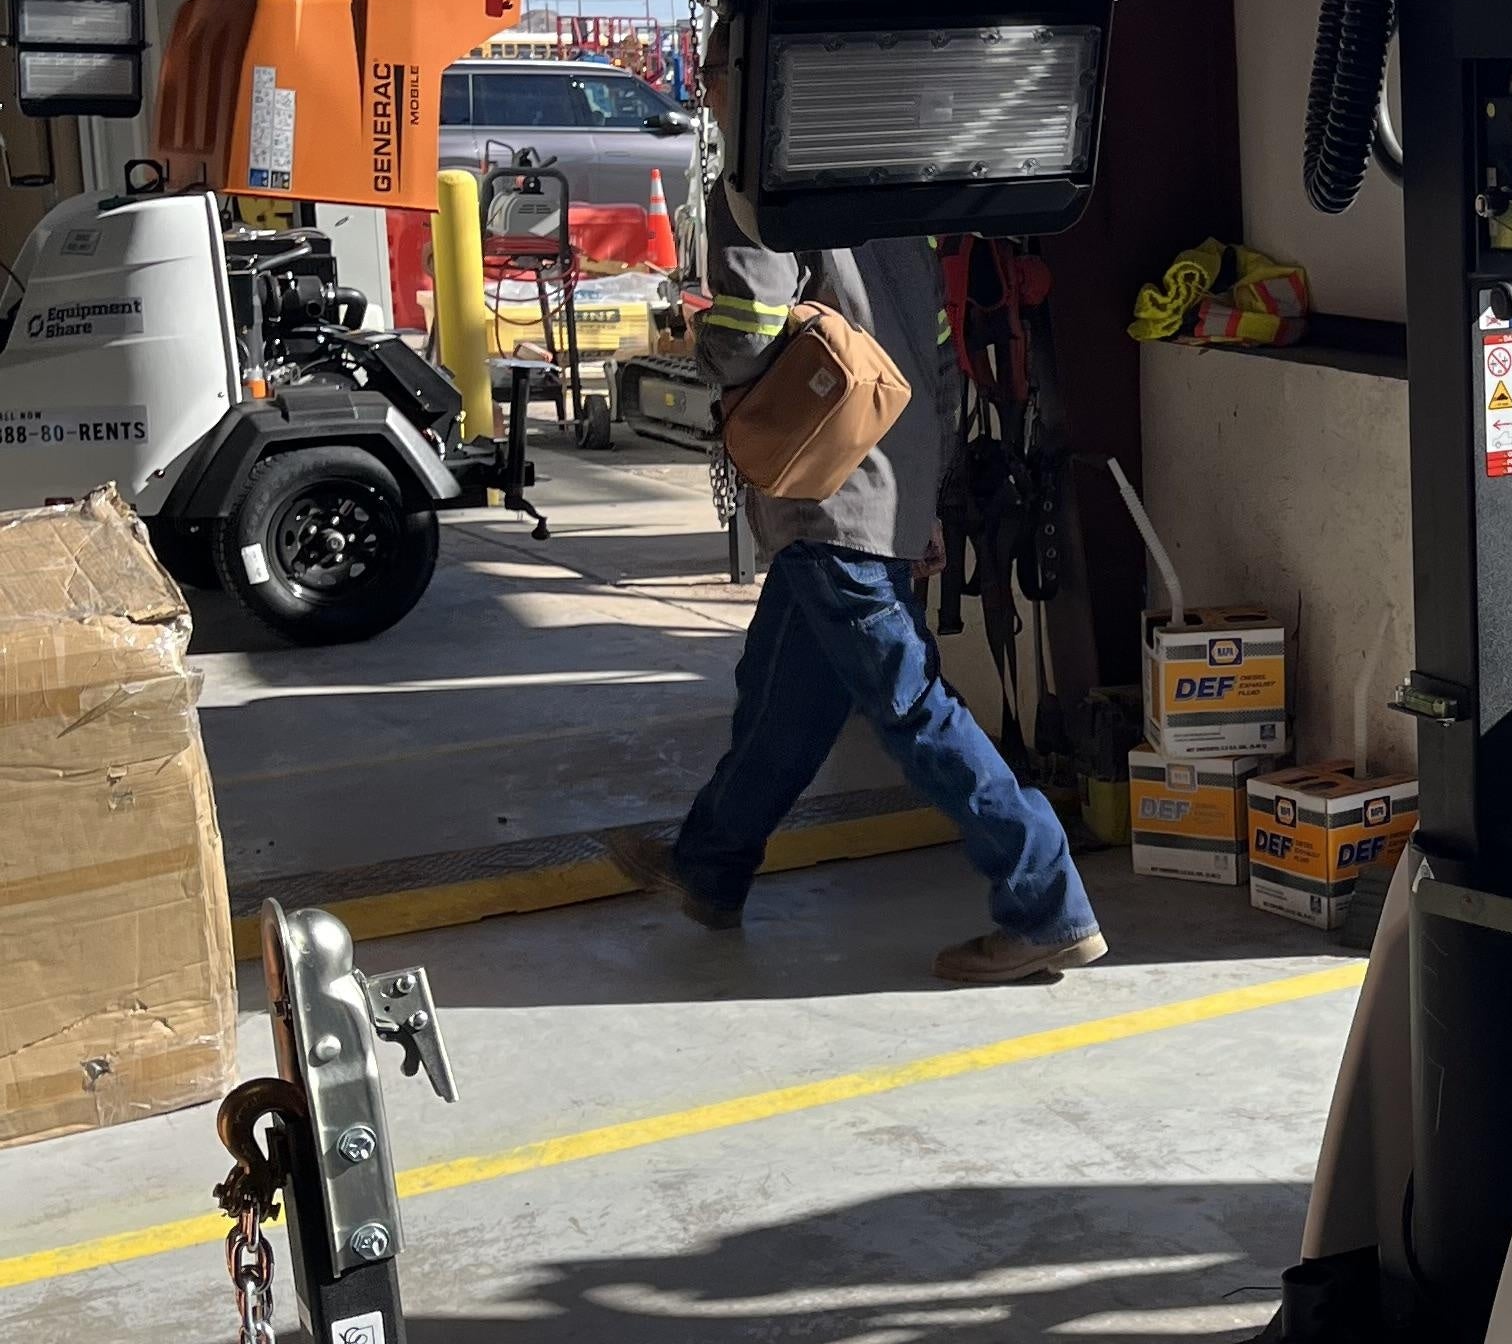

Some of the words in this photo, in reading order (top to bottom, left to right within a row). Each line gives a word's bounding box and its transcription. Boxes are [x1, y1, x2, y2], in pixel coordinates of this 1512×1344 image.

[410, 66, 419, 125] MOBILE
[373, 63, 392, 193] GENERAC
[47, 300, 142, 322] Equipment
[46, 322, 92, 338] Share
[0, 422, 146, 444] 88-80-RENTS
[1175, 676, 1236, 701] DEF
[1139, 796, 1191, 822] DEF
[1254, 828, 1293, 857] DEF
[1337, 835, 1387, 869] DEF
